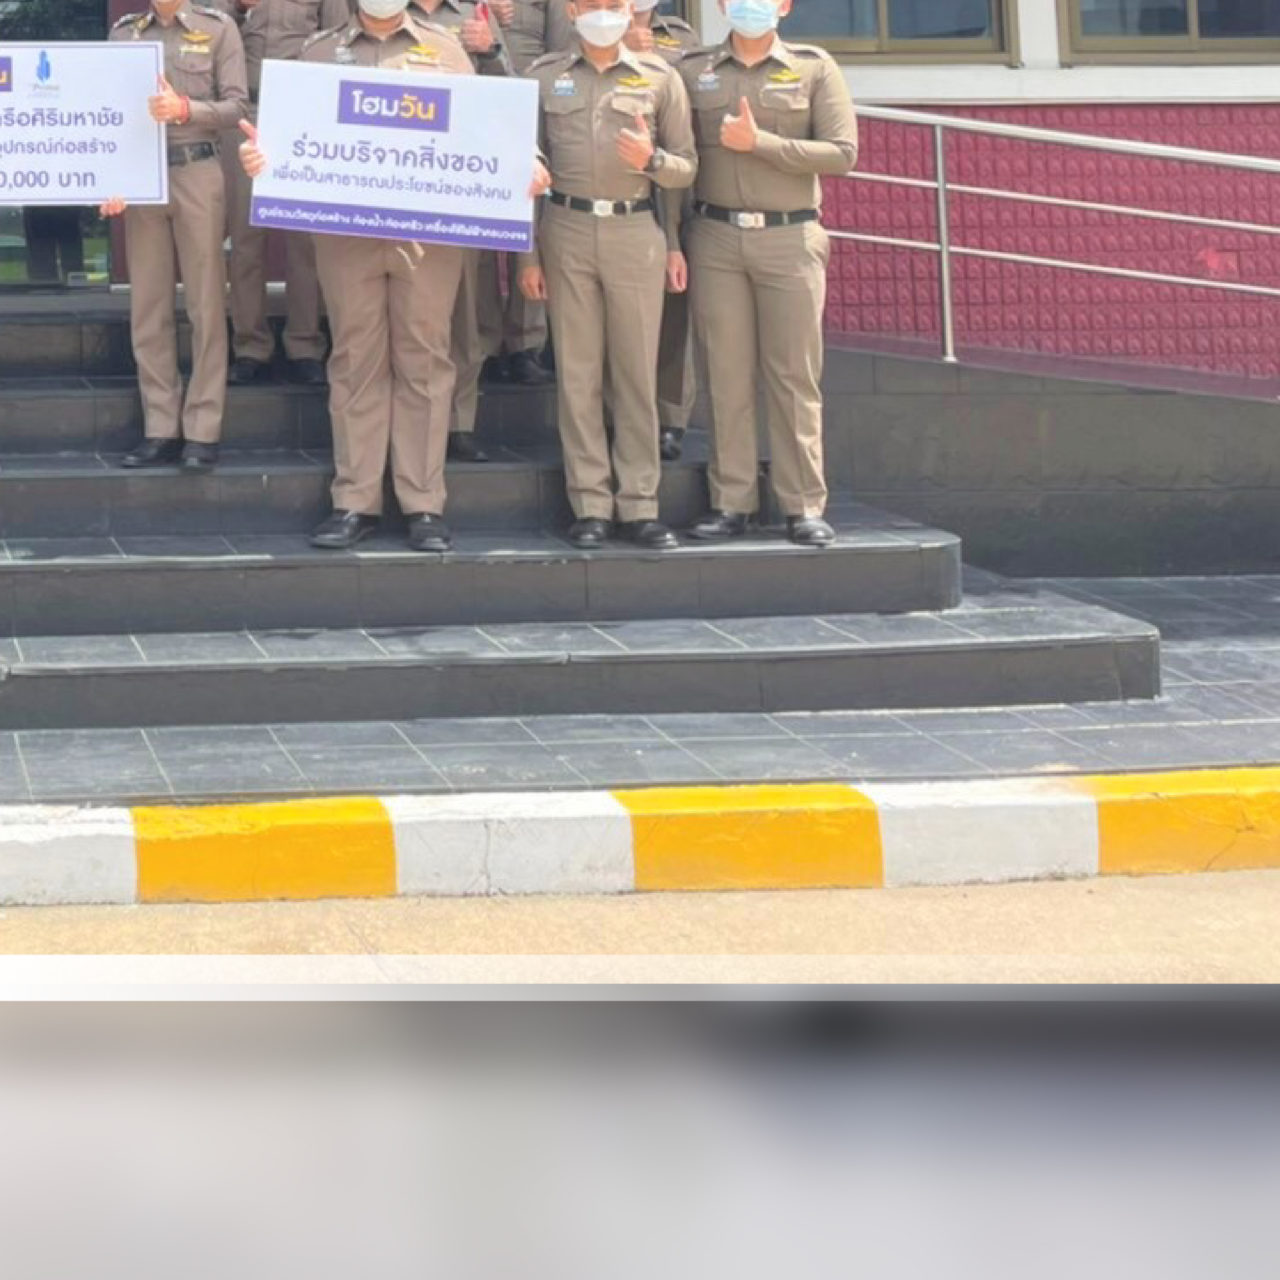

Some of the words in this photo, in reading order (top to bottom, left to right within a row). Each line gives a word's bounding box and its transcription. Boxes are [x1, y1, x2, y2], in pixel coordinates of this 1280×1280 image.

[352, 89, 436, 120] โฮมวัน
[292, 132, 499, 175] ร่วมบริจาคสิ่งของ
[58, 171, 97, 189] บาท
